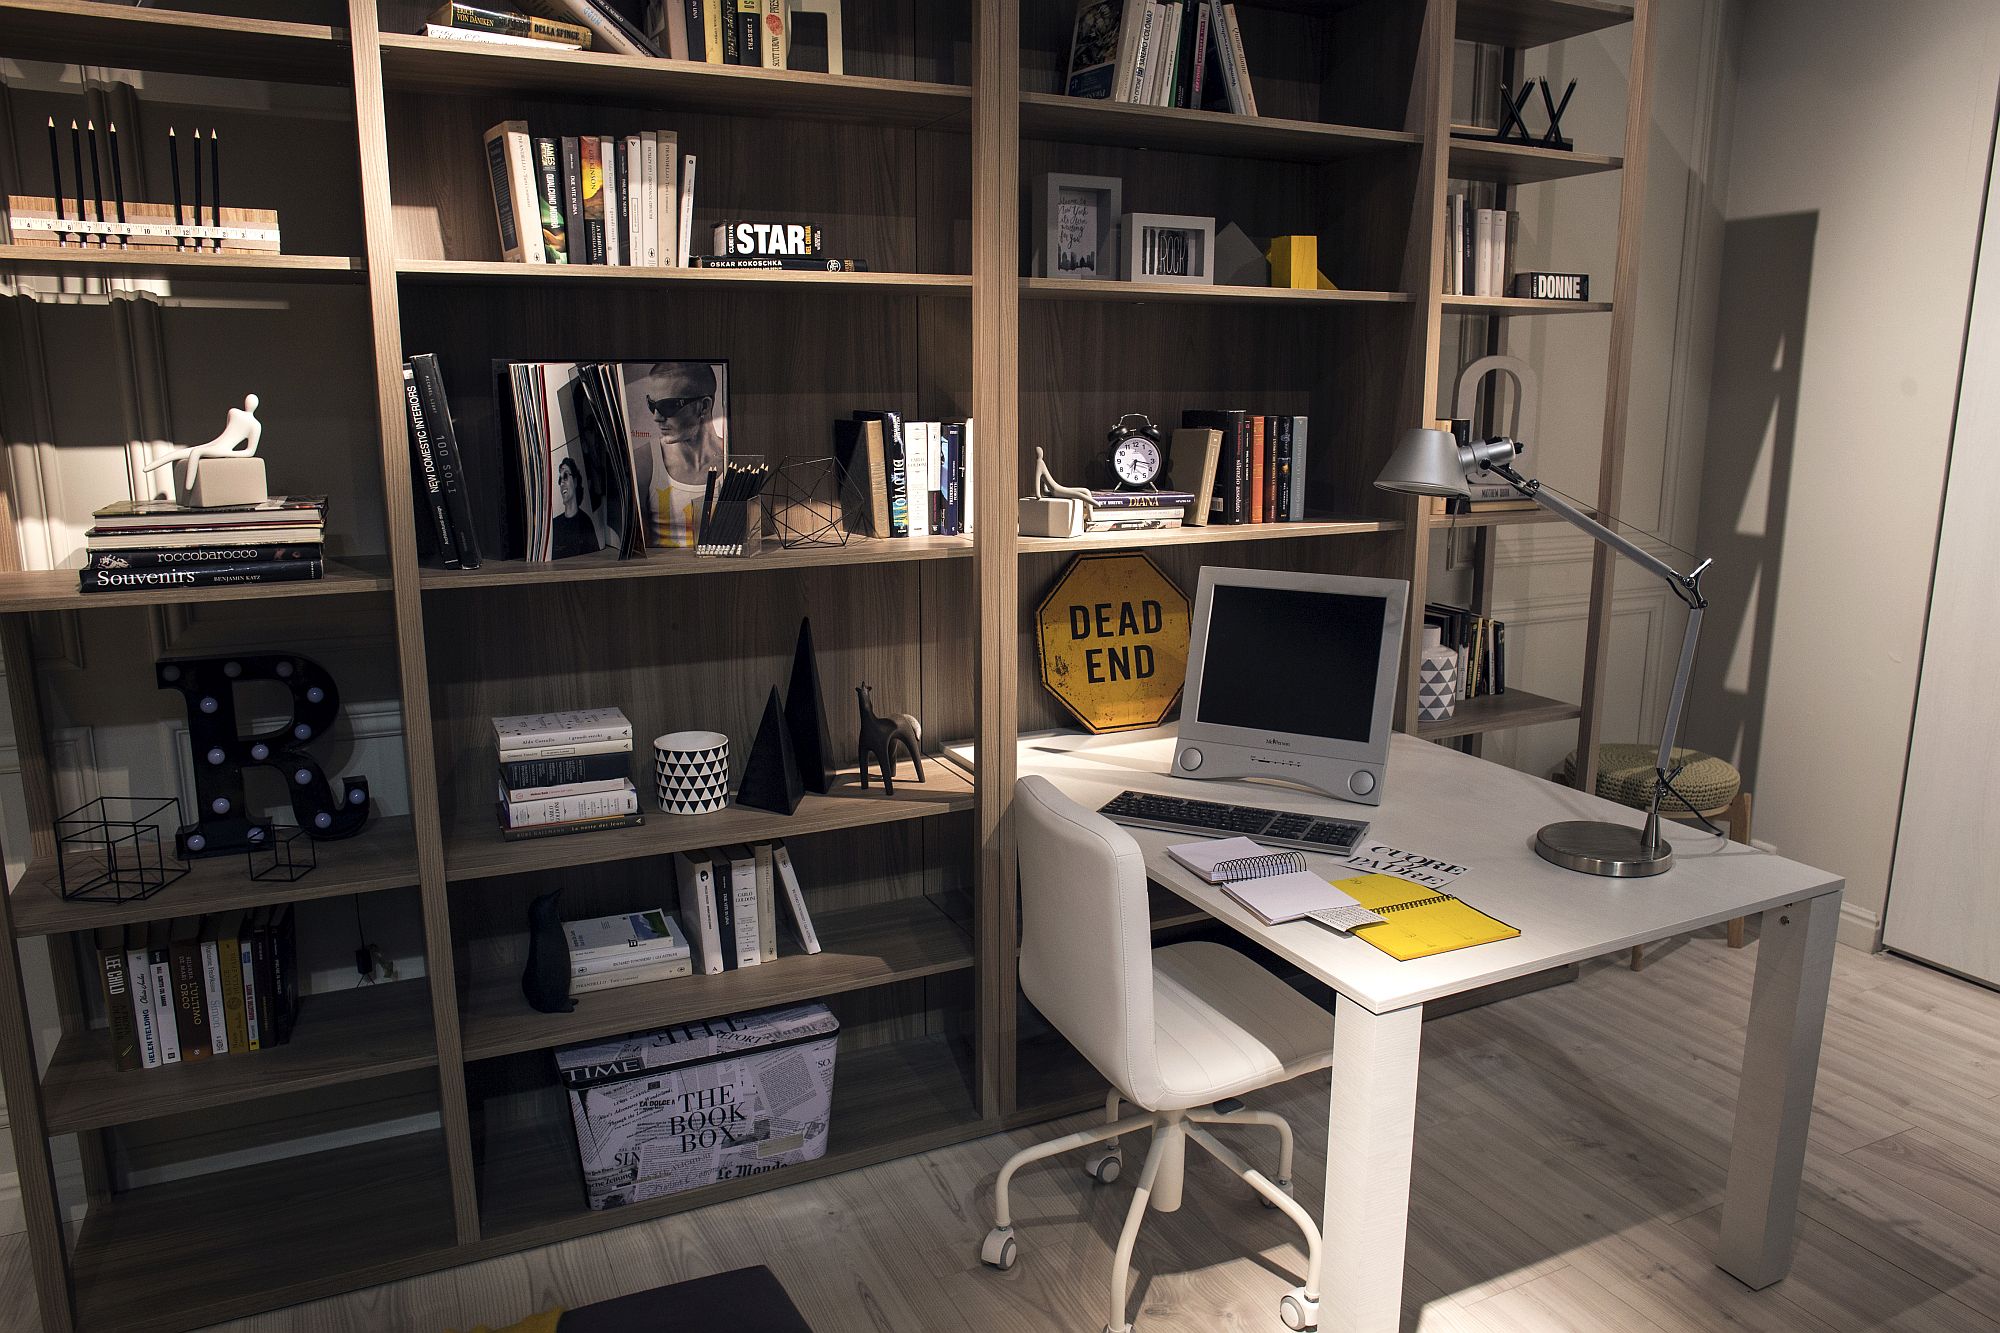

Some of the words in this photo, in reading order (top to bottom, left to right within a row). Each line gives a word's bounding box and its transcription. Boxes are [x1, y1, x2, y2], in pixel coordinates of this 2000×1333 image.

[456, 13, 469, 22] VON
[534, 23, 555, 37] DELLA
[546, 173, 557, 205] QUALCUNO
[736, 223, 806, 255] STAR
[737, 259, 783, 267] KOKOSCHKA
[1160, 235, 1186, 274] ROCK
[1538, 275, 1581, 299] DONNE
[406, 384, 423, 431] INTERIORS
[416, 429, 435, 475] DOMESTIC
[436, 435, 449, 457] 100
[428, 473, 440, 494] NEW
[442, 463, 457, 494] SOLI
[891, 458, 908, 506] DILUVIO
[1128, 497, 1159, 507] DIANA
[157, 548, 258, 563] roccobarocco
[97, 568, 195, 586] Souvenirs
[1069, 599, 1163, 641] DEAD
[1085, 644, 1155, 684] END
[155, 650, 370, 860] R
[1346, 856, 1446, 889] PADRE
[1370, 846, 1468, 877] CUORE
[104, 955, 121, 971] LEE
[108, 969, 125, 995] CHILD
[180, 983, 190, 1010] ORCO
[189, 981, 202, 1026] L'ULTIMO
[210, 999, 221, 1028] Simon
[143, 1008, 153, 1040] FIELDING
[147, 1040, 156, 1063] HELEN
[562, 1058, 639, 1082] TIME
[649, 1099, 671, 1107] DOLCE
[678, 1084, 735, 1114] THE
[670, 1101, 746, 1136] BOOK
[681, 1123, 737, 1153] BOX
[717, 1167, 734, 1180] Le
[735, 1160, 788, 1179] Monde
